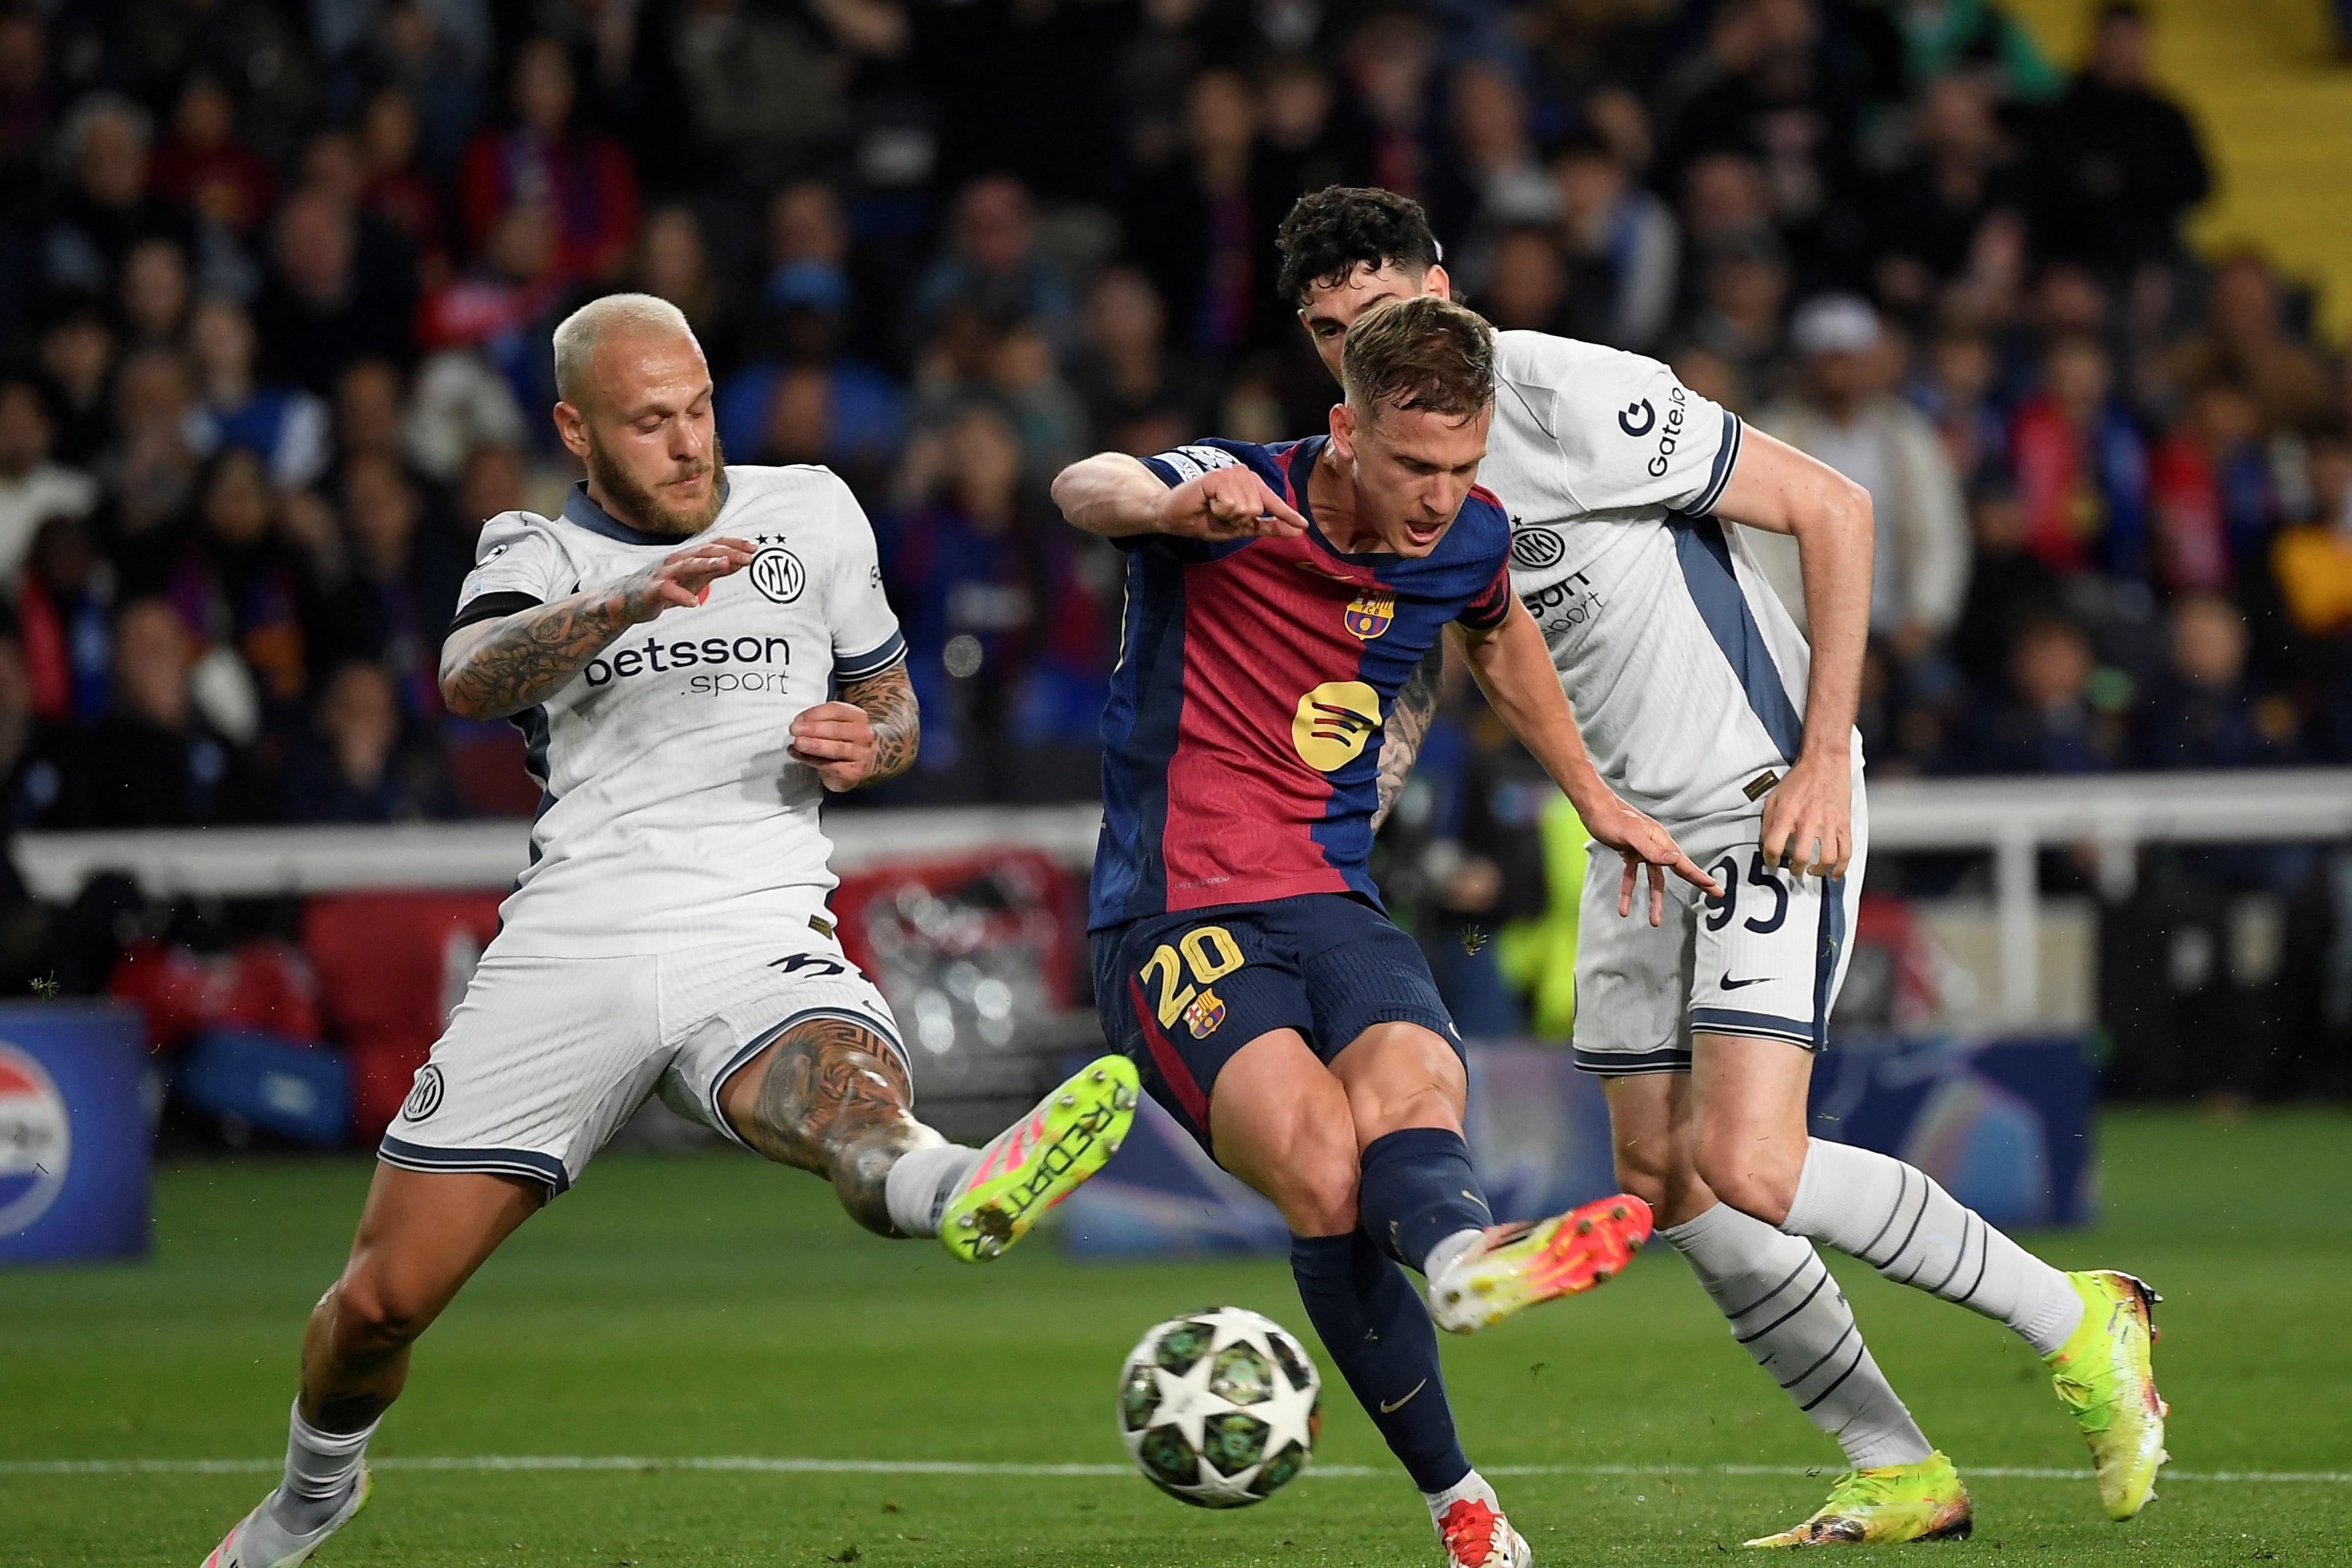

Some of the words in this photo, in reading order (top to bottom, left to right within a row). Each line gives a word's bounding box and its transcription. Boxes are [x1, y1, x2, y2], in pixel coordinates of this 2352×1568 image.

[1647, 387, 1686, 477] Gate.io
[1361, 605, 1381, 615] FCB
[681, 669, 789, 697] .sport
[1704, 851, 1789, 935] 95
[1139, 925, 1245, 1030] 20
[959, 1077, 1135, 1259] PREDATR
